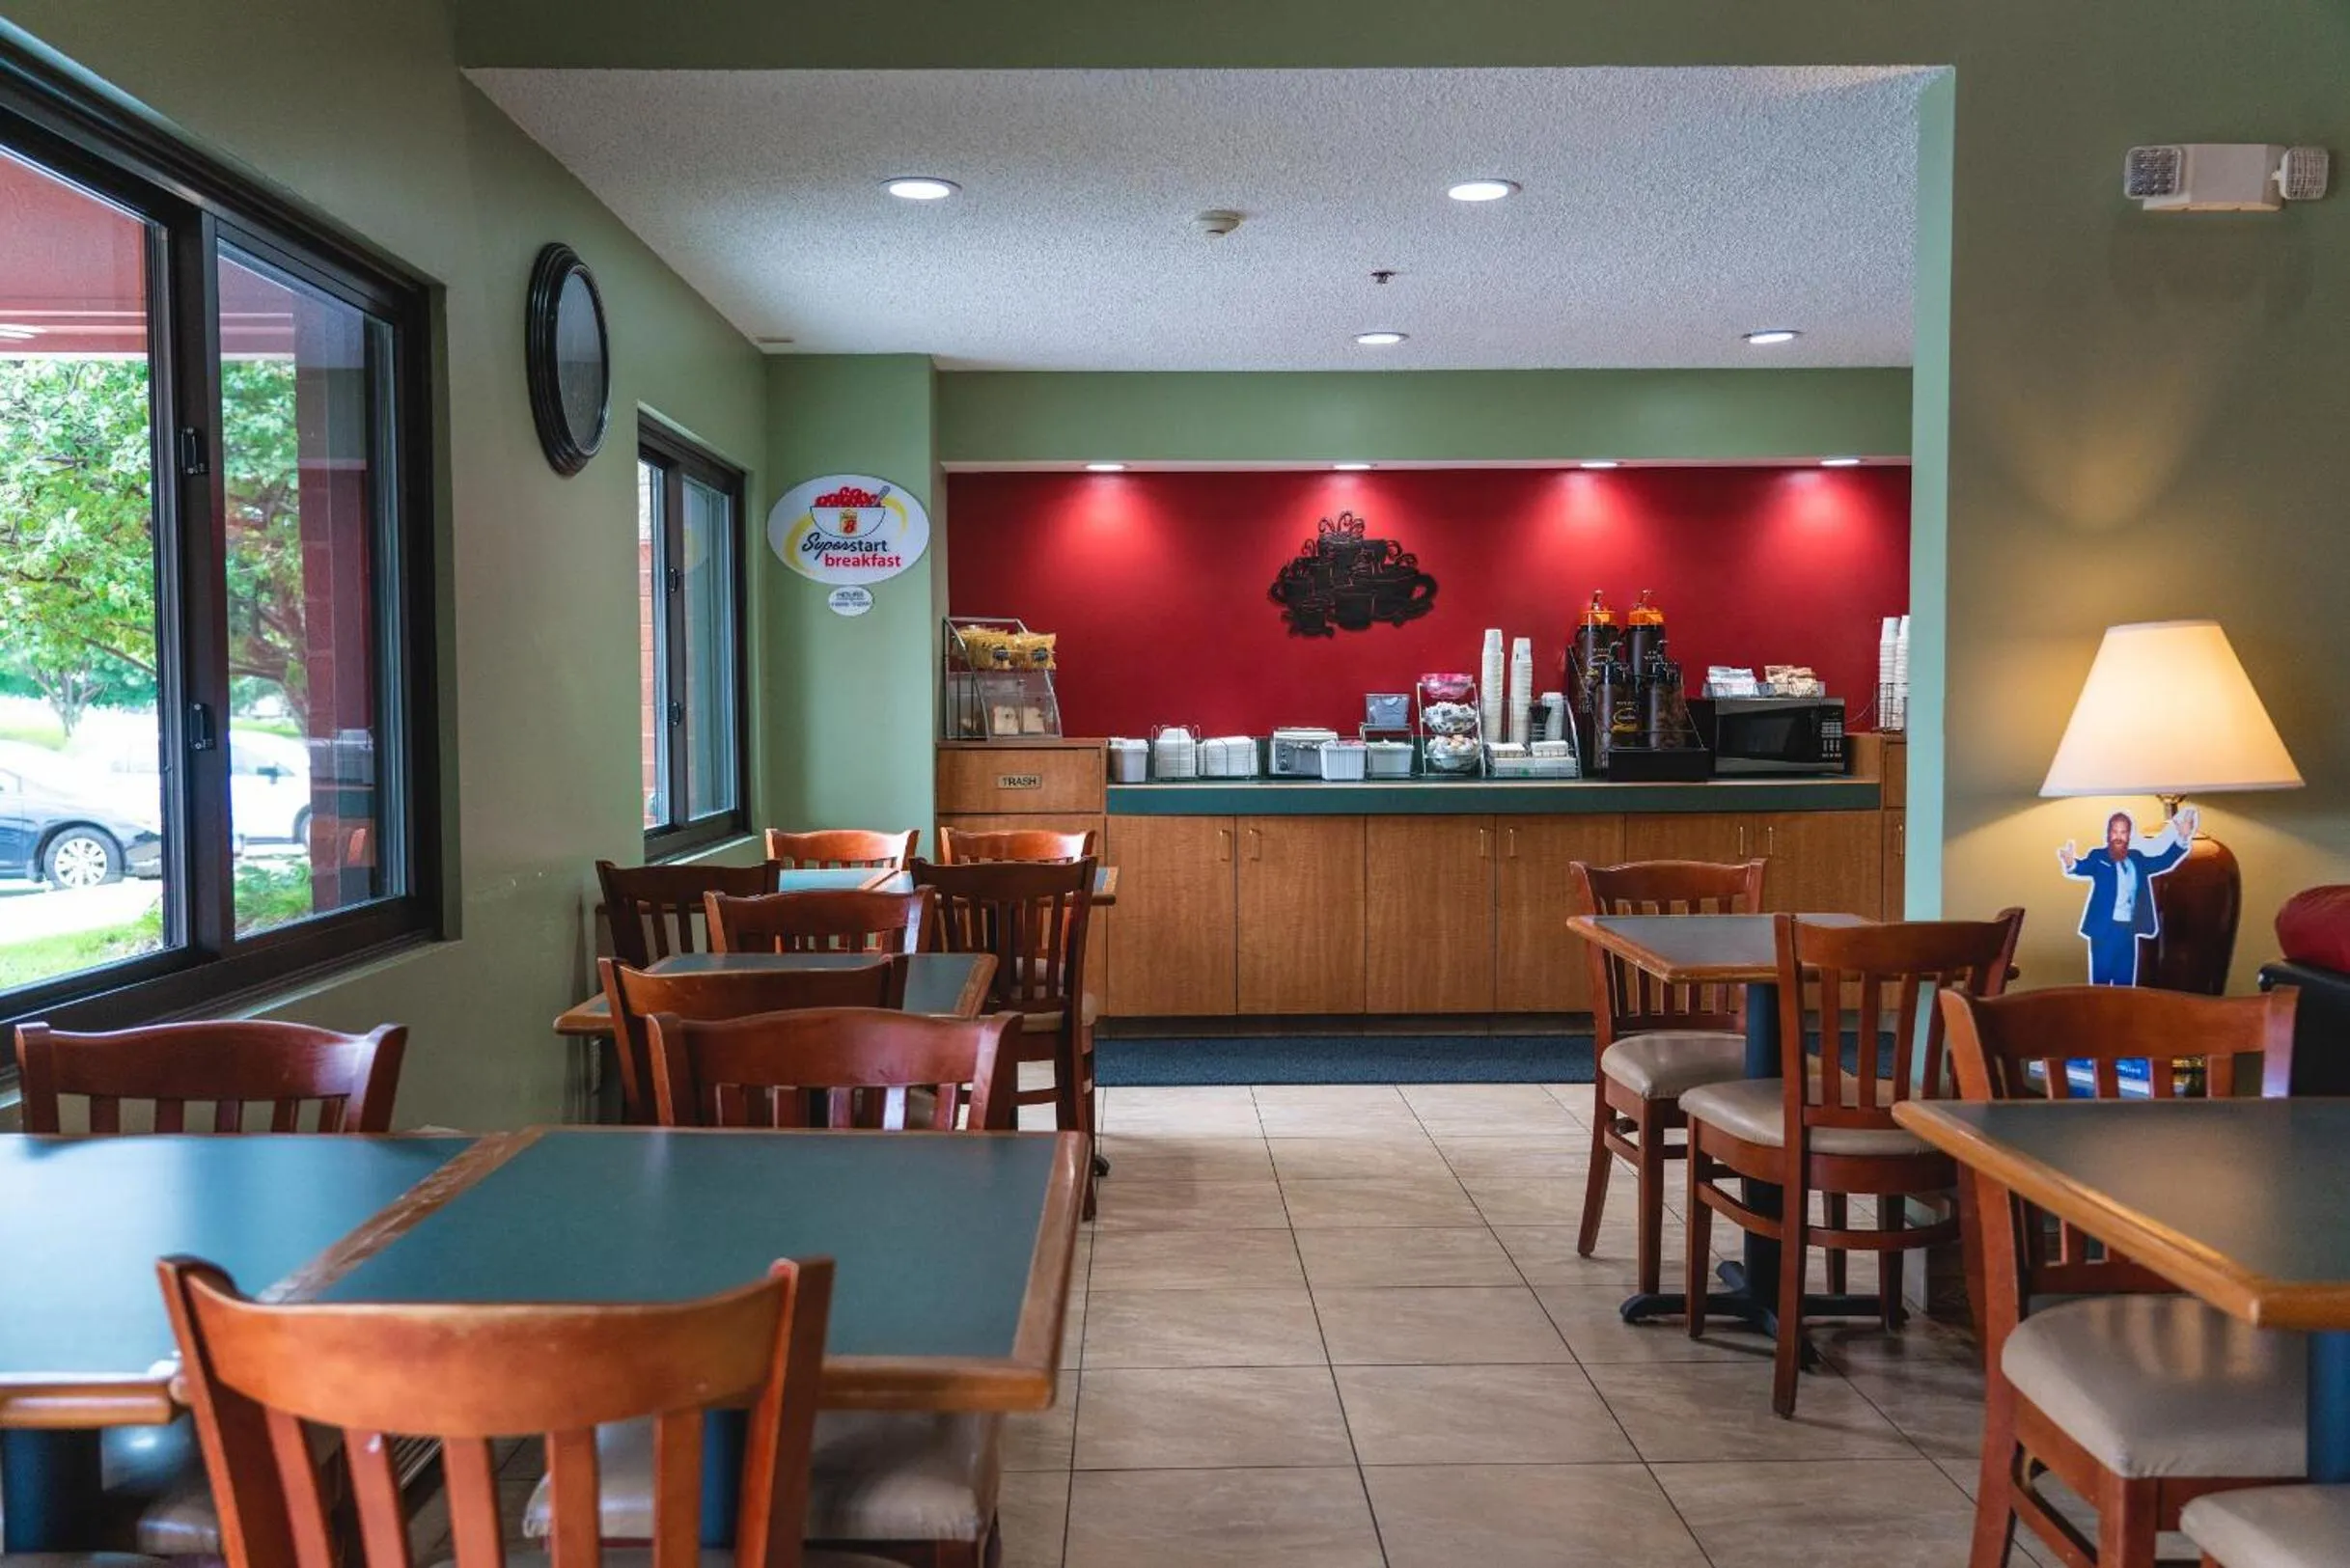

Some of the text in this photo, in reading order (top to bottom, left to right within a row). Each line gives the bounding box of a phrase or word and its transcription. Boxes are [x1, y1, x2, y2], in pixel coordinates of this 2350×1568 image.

[802, 533, 888, 560] Superstart
[824, 553, 901, 567] breakfast
[1003, 776, 1037, 787] TRASH
